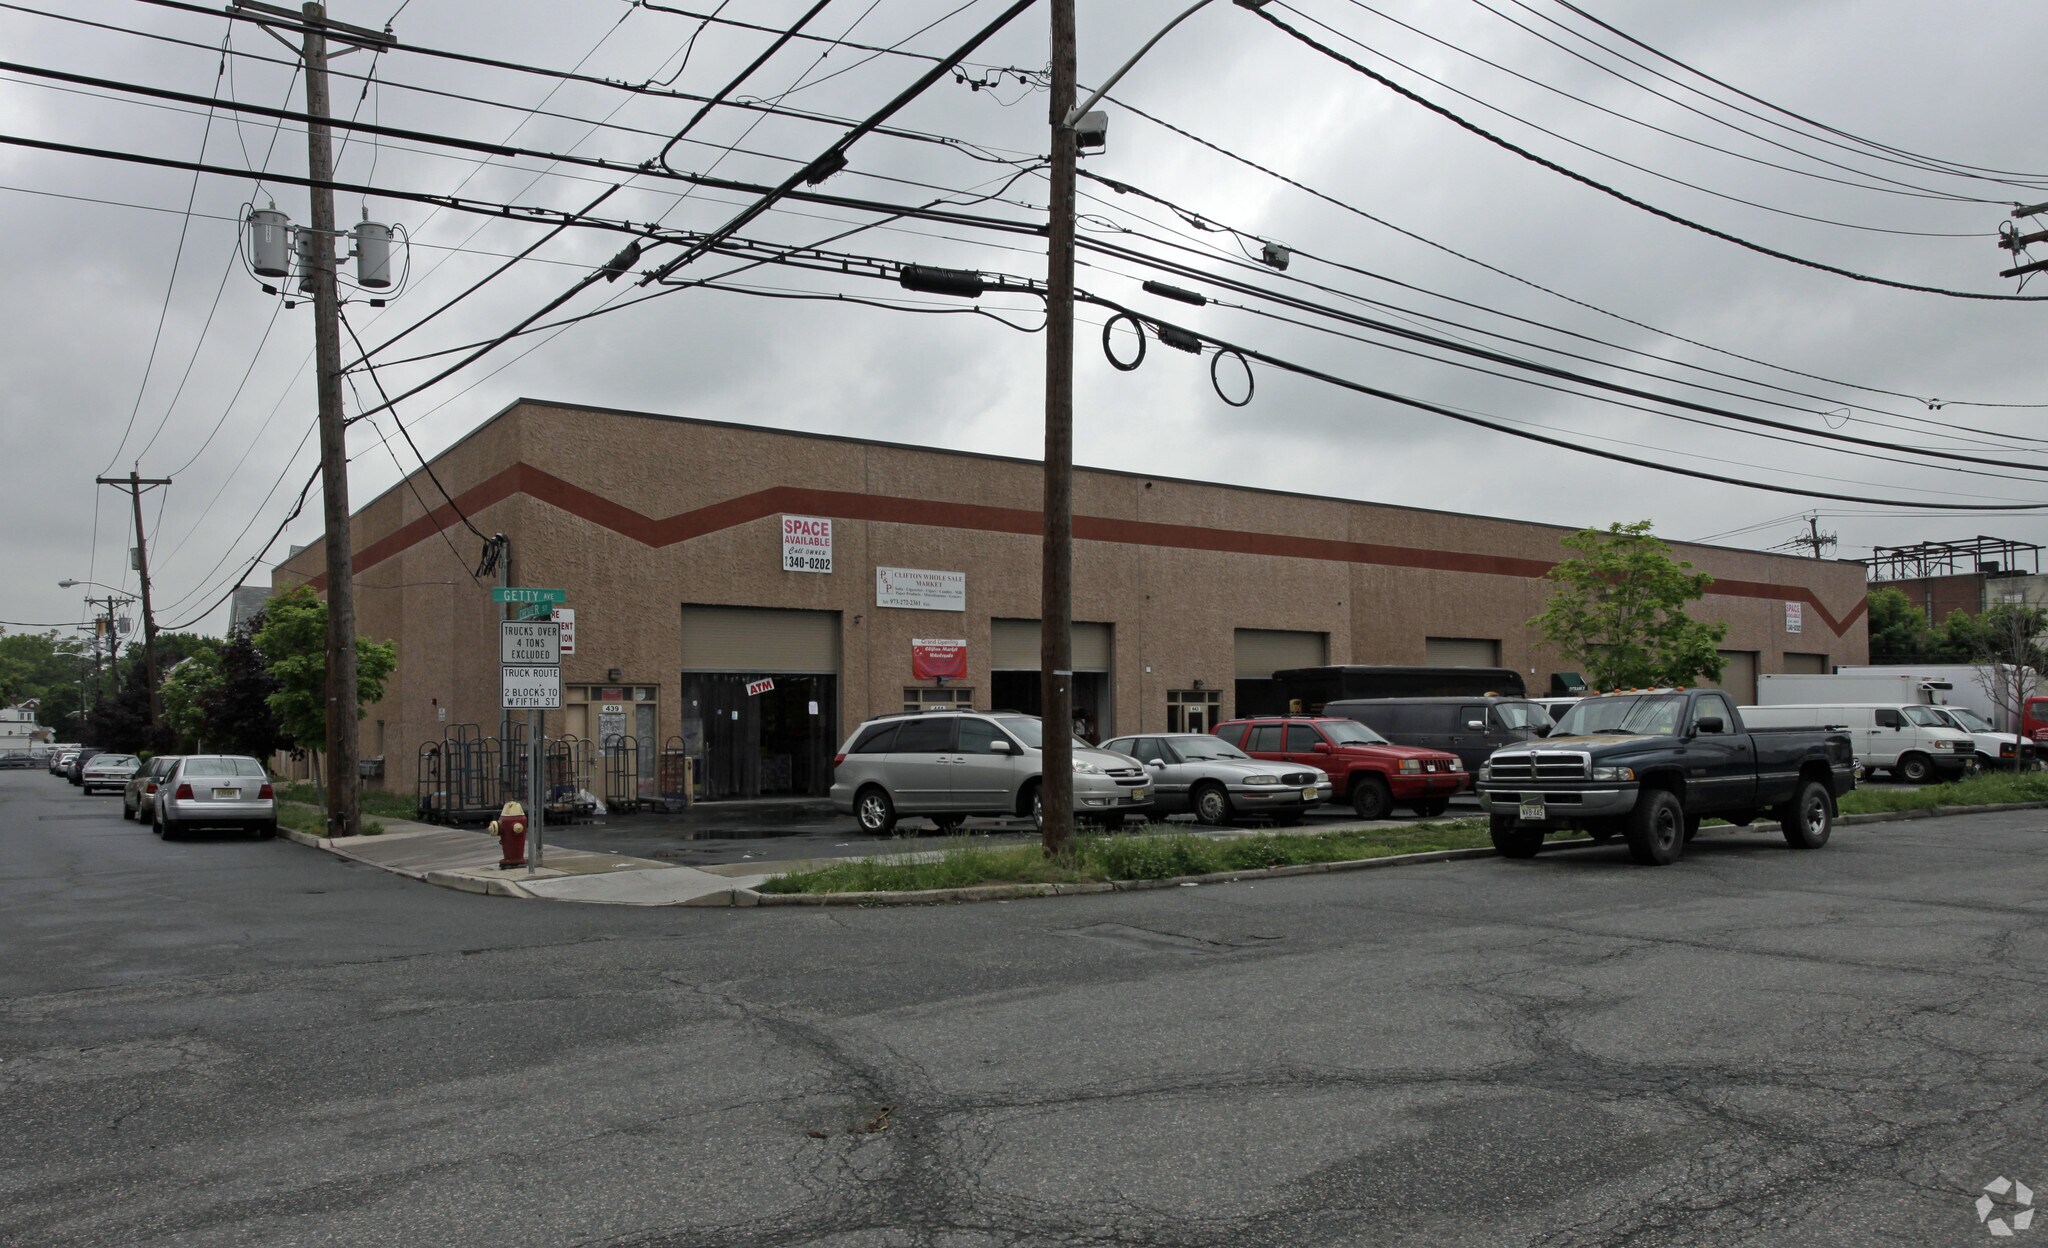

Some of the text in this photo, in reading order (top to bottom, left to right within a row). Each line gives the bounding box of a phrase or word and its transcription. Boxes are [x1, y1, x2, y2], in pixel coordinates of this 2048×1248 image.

[784, 519, 829, 536] SPACE
[784, 536, 830, 547] AVAILABLE
[789, 556, 831, 570] 340-0202
[880, 570, 886, 579] P
[894, 572, 922, 580] CLIFTON
[886, 584, 892, 593] P
[504, 590, 539, 601] GETTY
[542, 604, 548, 612] ST
[1786, 604, 1800, 613] SPACE
[505, 627, 557, 636] TRUCKS OVER
[526, 639, 544, 648] TONS
[512, 650, 550, 660] EXCLUDED
[505, 668, 558, 678] TRUCK ROUTE
[750, 680, 772, 694] ATM
[545, 698, 556, 706] ST.
